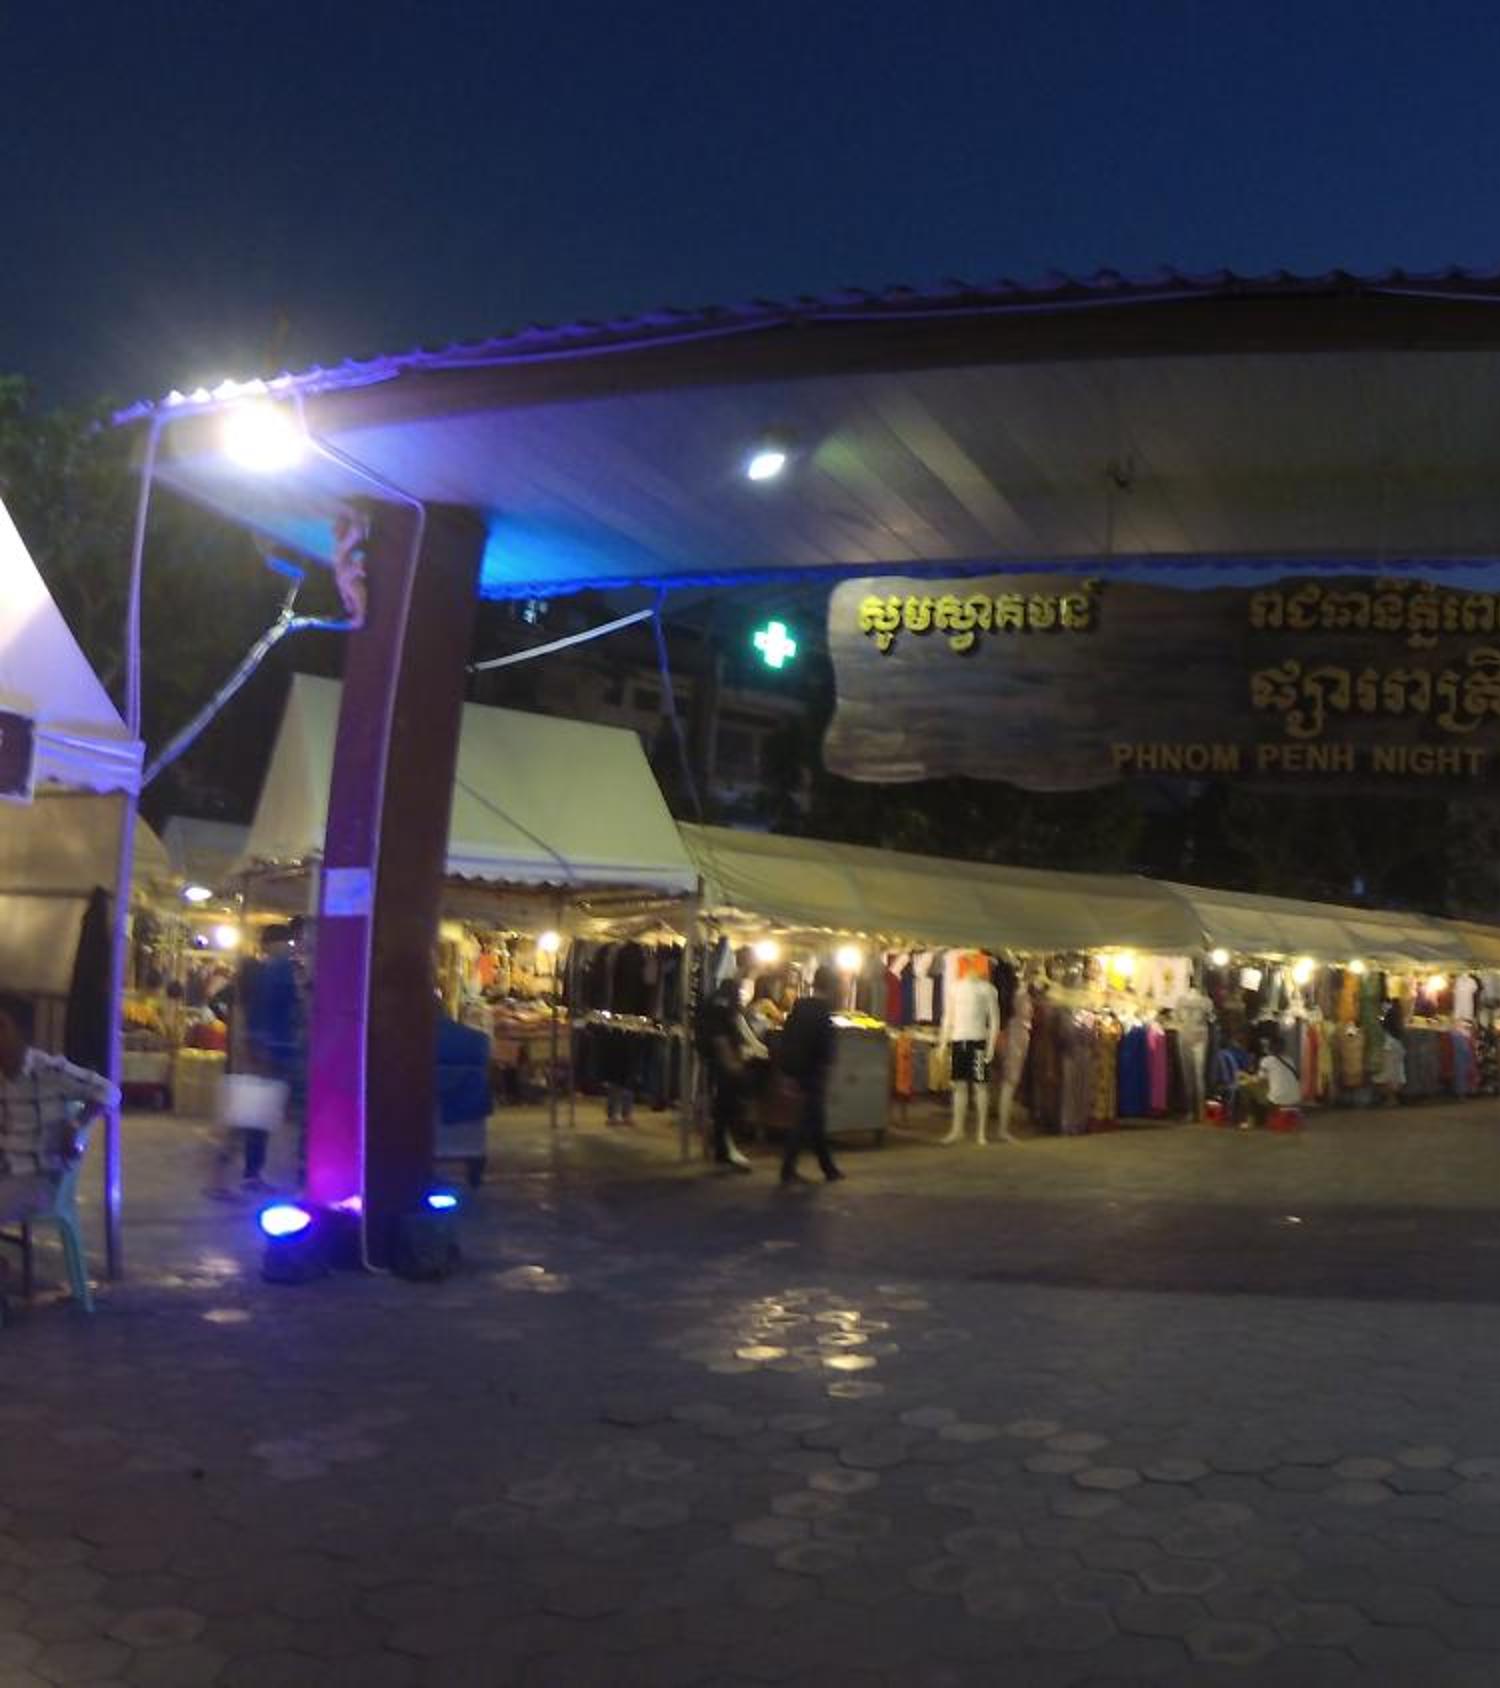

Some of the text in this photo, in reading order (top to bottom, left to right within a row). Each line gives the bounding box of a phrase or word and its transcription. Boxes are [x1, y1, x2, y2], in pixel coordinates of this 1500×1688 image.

[1111, 743, 1239, 775] PHNOM
[1257, 745, 1356, 773] PENH
[1374, 747, 1485, 775] NIGHT
